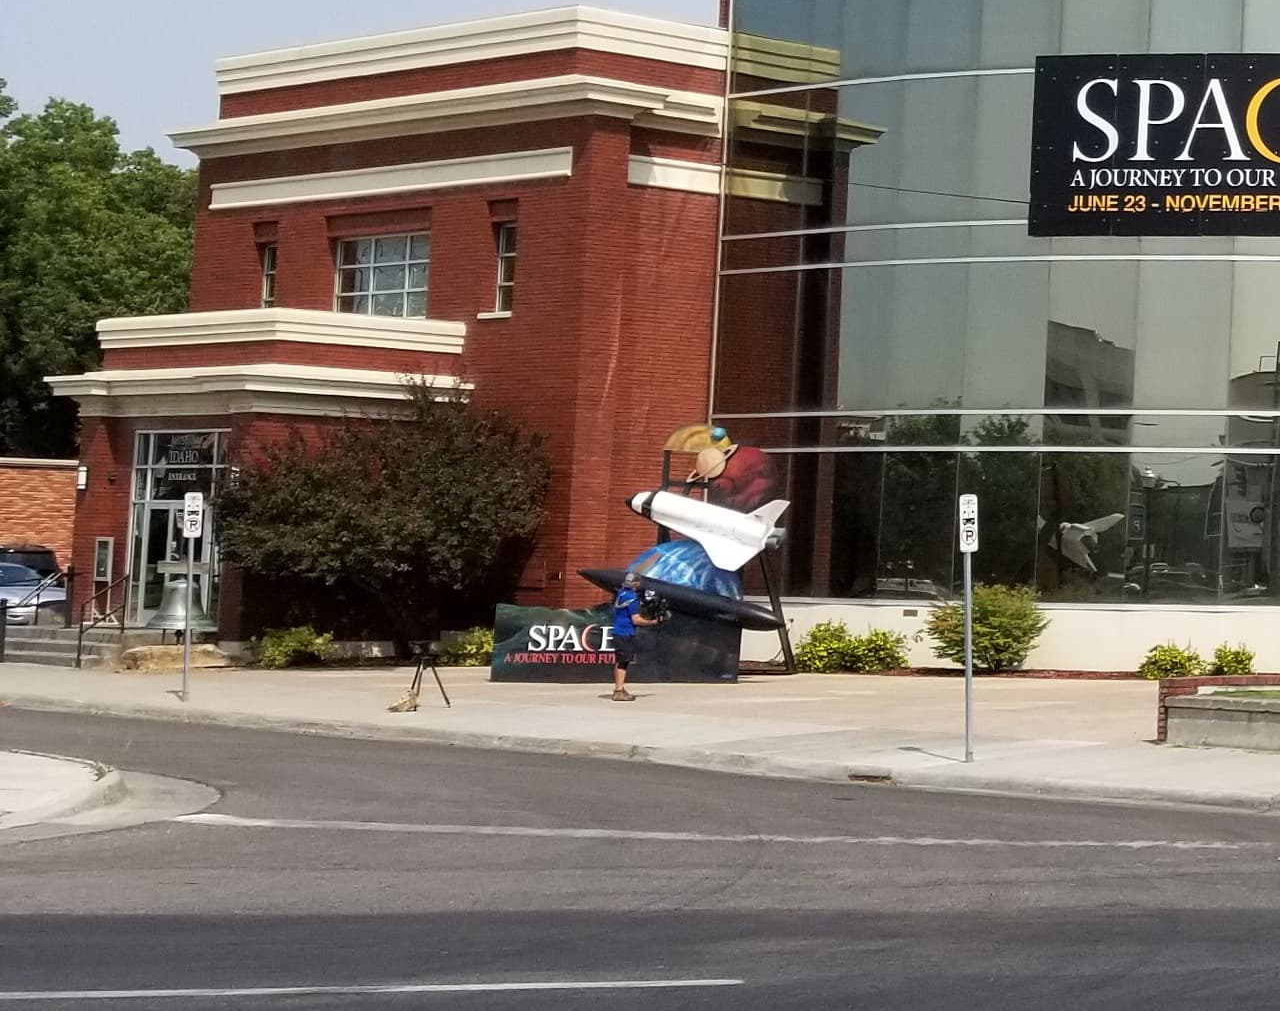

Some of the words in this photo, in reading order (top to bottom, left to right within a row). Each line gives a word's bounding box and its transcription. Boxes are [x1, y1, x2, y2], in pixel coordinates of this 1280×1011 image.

[1070, 169, 1085, 187] A
[1088, 169, 1186, 189] JOURNEY
[1190, 169, 1222, 187] TO
[1226, 169, 1280, 188] OUR
[1068, 195, 1118, 212] JUNE
[1123, 195, 1146, 212] 23
[170, 450, 199, 463] IDAHO
[528, 624, 615, 651] SPACE
[504, 653, 511, 663] A
[513, 653, 559, 664] JOURNEY
[561, 653, 575, 664] TO
[575, 653, 596, 664] OUR
